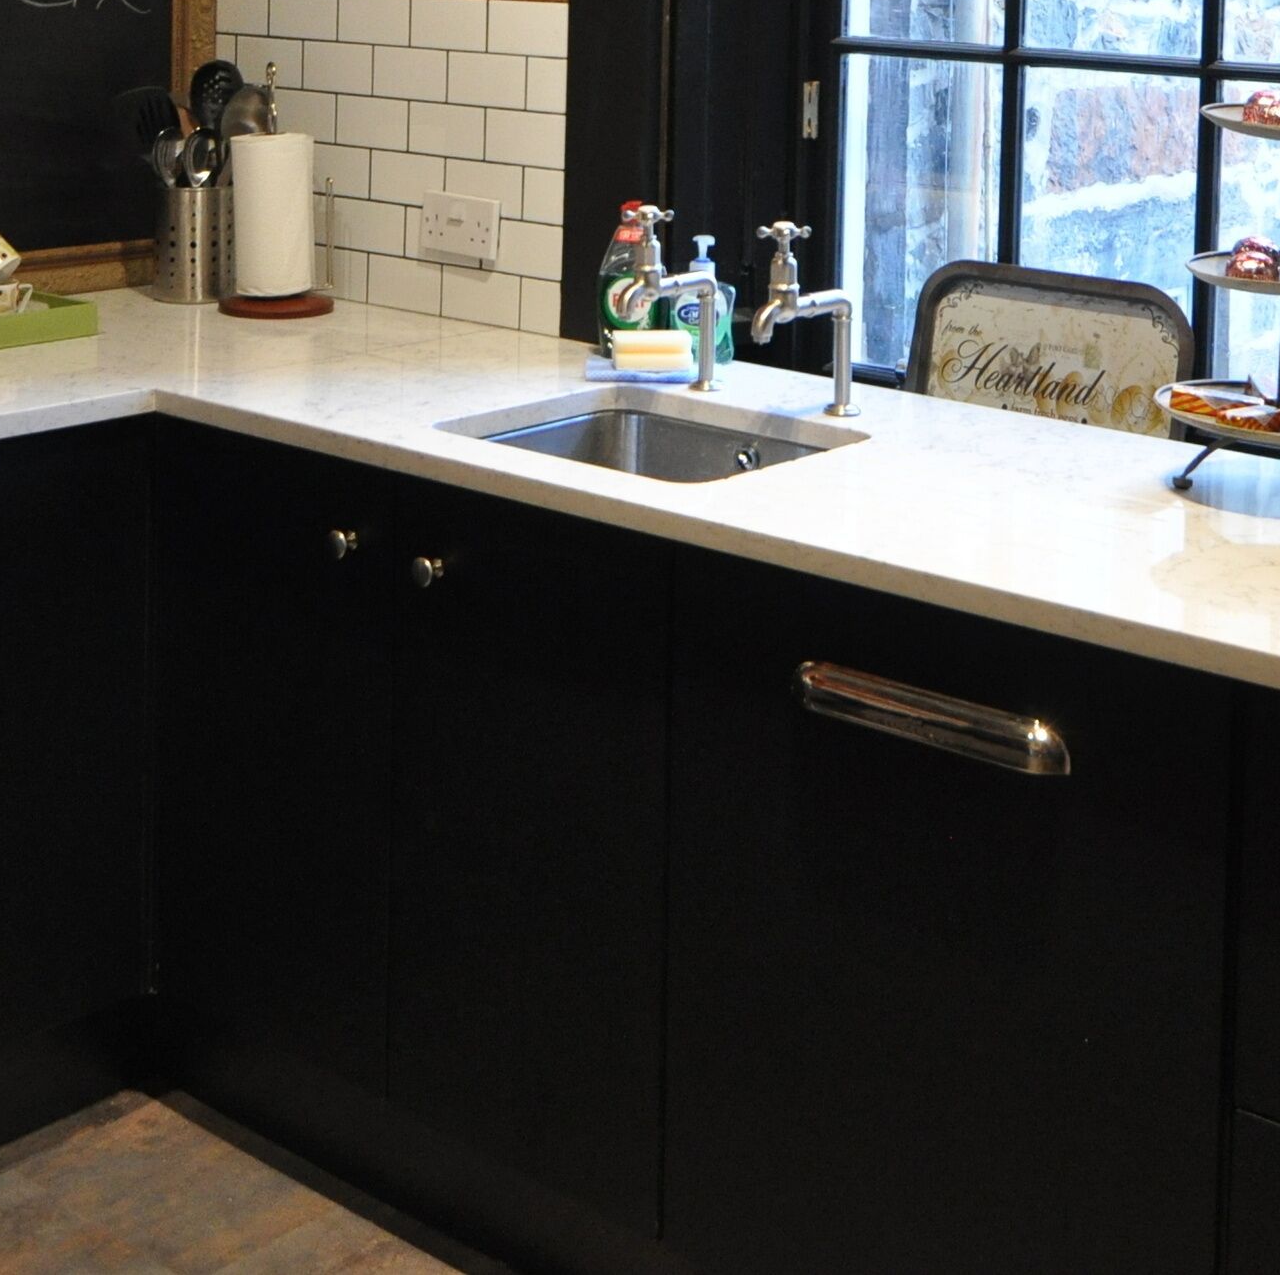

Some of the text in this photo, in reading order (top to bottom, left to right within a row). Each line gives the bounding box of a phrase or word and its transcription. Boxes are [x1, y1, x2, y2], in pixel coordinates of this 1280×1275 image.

[941, 319, 982, 336] from the
[942, 340, 1106, 407] Heartland
